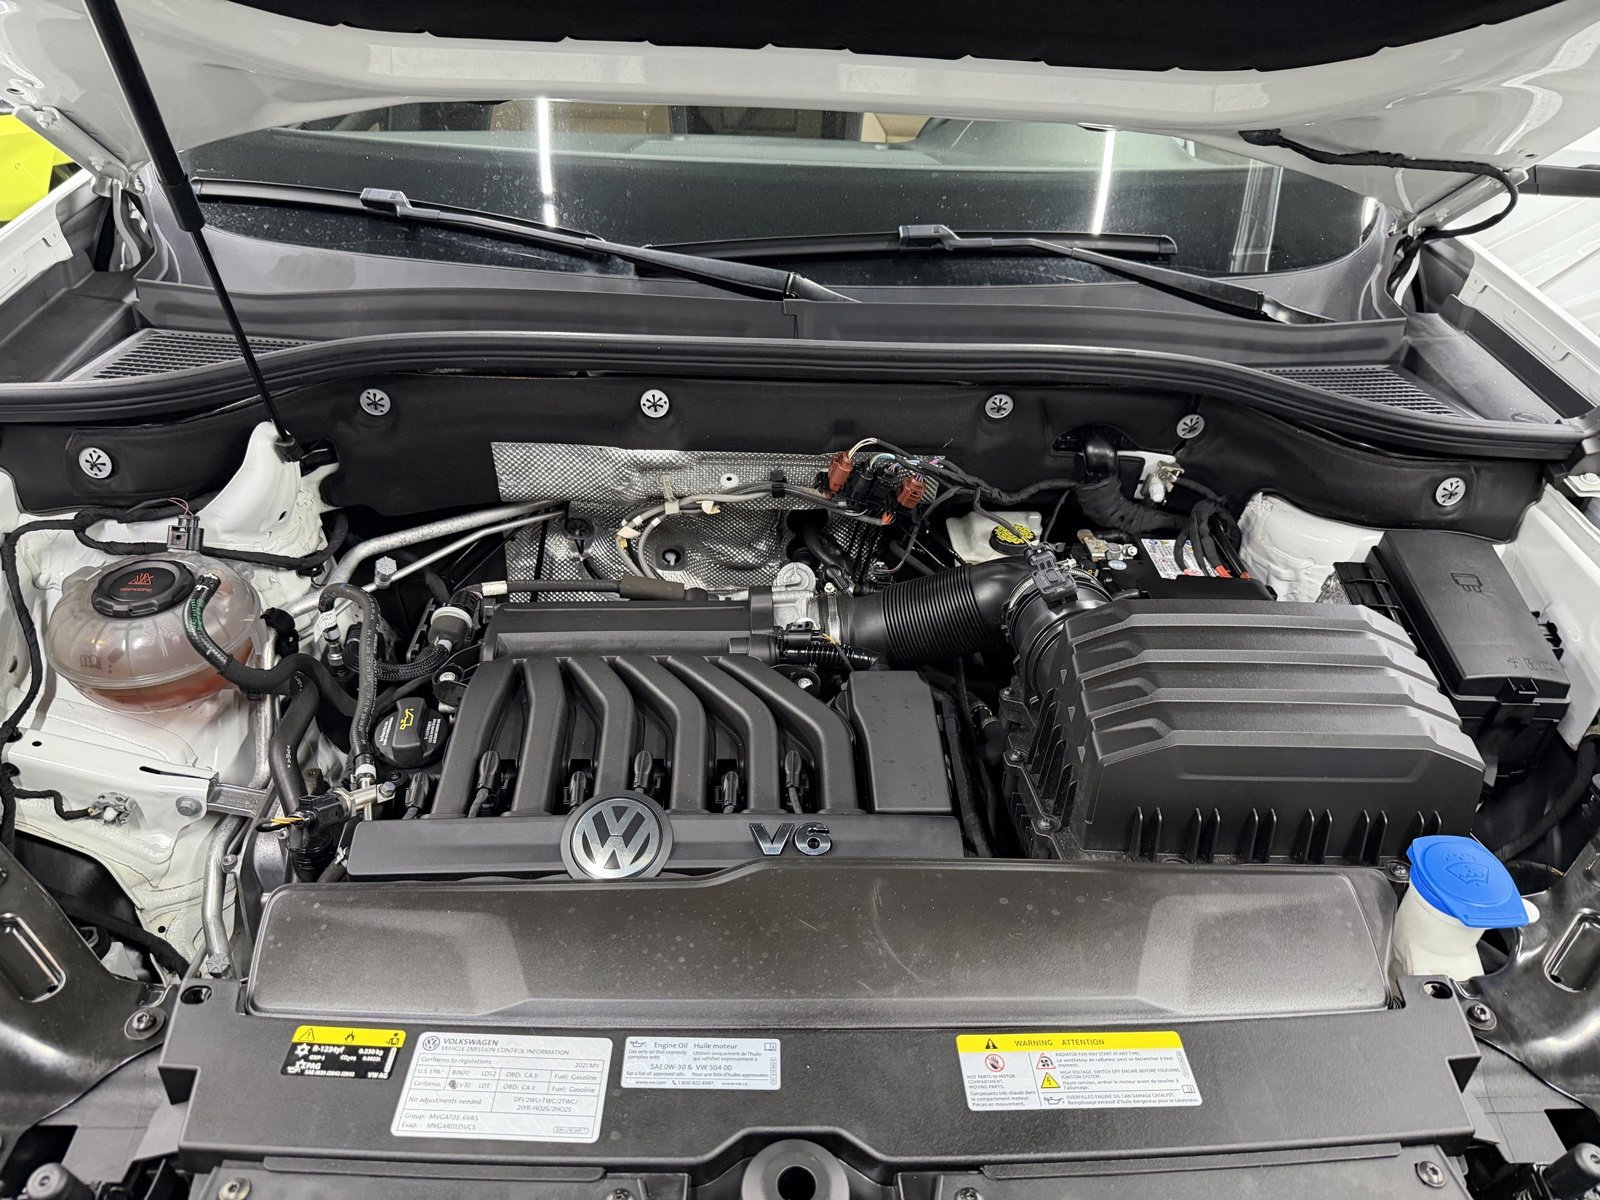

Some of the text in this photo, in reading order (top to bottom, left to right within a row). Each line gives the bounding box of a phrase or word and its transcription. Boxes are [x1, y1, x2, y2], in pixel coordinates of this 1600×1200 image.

[571, 798, 662, 879] VW
[749, 822, 832, 856] V6
[423, 1036, 440, 1051] VW
[443, 1038, 499, 1046] VOLKSWAGEN
[312, 1045, 345, 1054] R-1234yf
[306, 1062, 322, 1070] PAG
